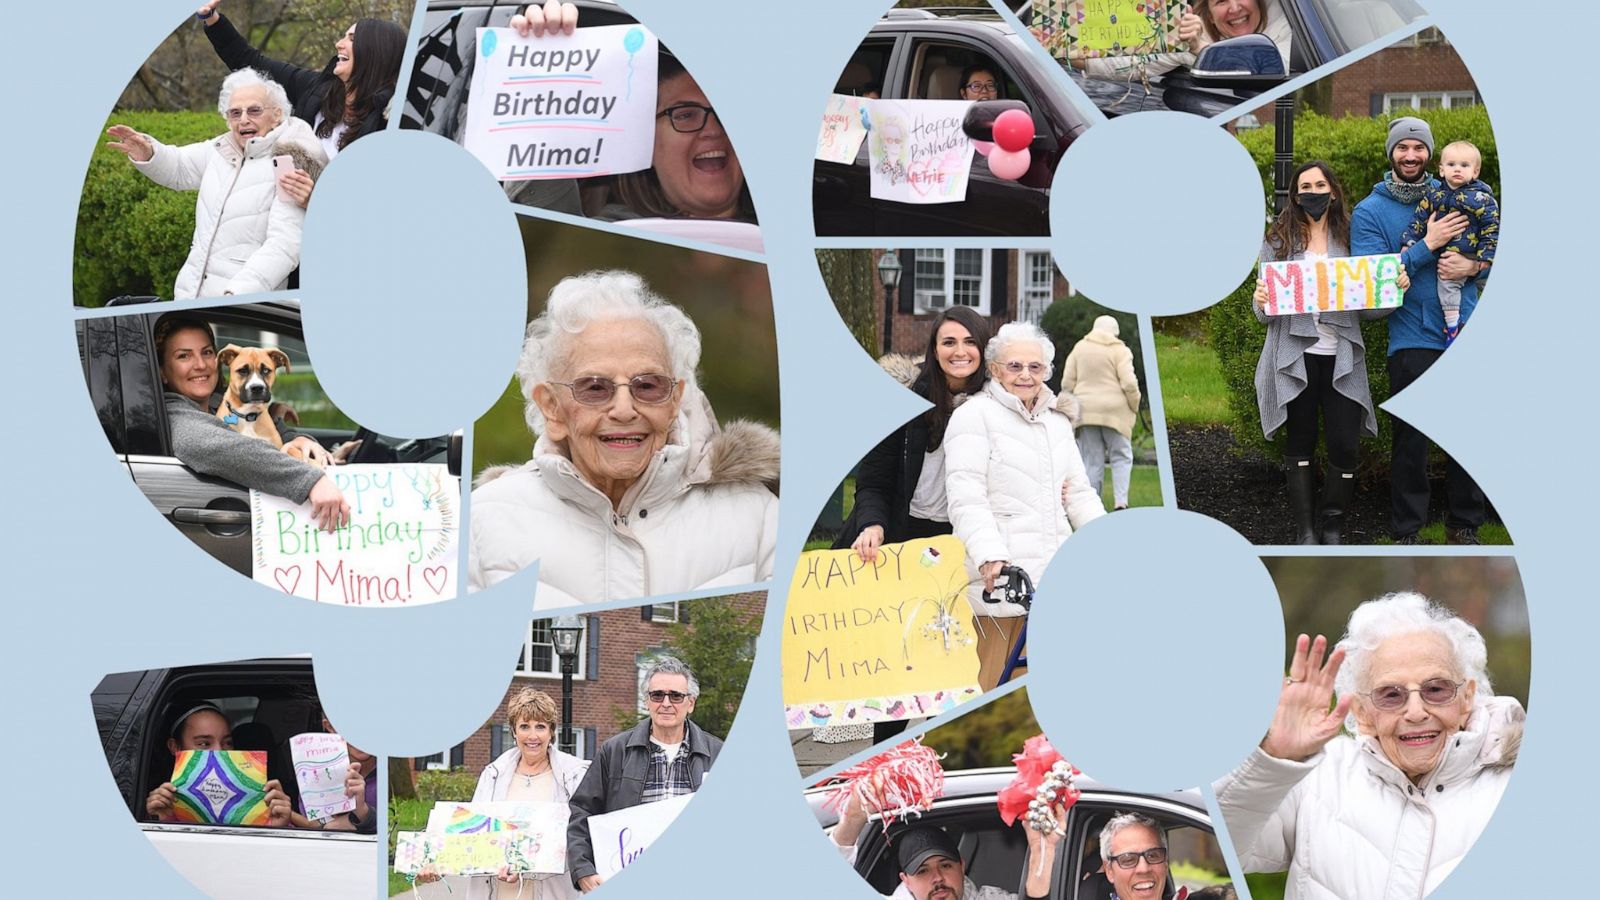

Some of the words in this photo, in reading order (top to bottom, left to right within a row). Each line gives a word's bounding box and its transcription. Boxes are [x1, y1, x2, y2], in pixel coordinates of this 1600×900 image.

[507, 45, 601, 72] Happy
[493, 89, 616, 119] Birthday
[911, 112, 962, 142] Happy
[506, 138, 603, 167] Mima!
[1266, 256, 1403, 315] MIMA
[277, 510, 424, 564] Birthday
[315, 559, 413, 605] Mima!
[802, 544, 905, 591] HAPPY
